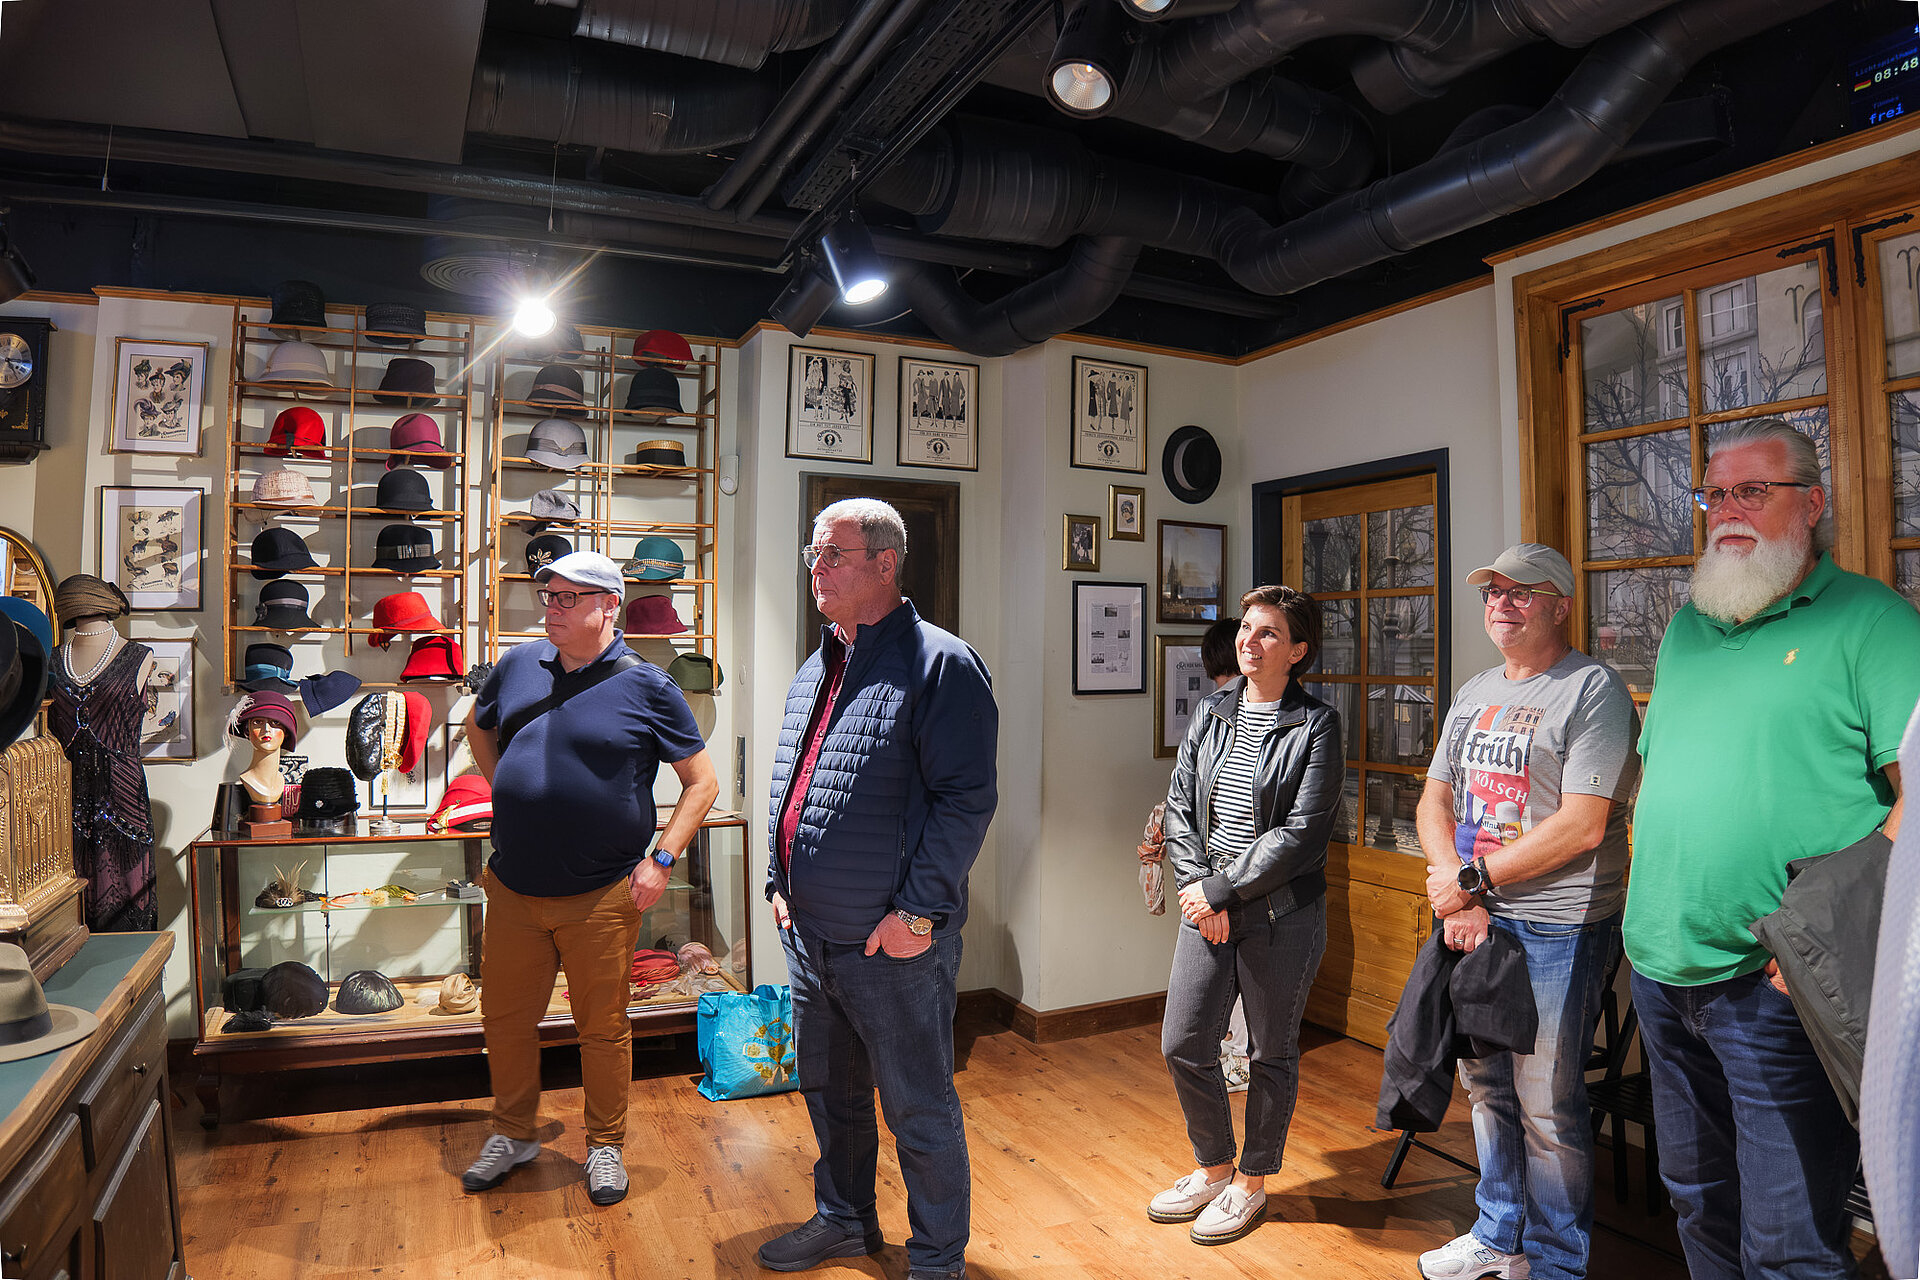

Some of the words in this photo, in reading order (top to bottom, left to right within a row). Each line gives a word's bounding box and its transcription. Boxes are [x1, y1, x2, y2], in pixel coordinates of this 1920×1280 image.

[1874, 56, 1919, 83] 08:48
[1869, 102, 1904, 125] frei
[1474, 771, 1528, 804] KÖLSCH
[1474, 1248, 1496, 1265] N
